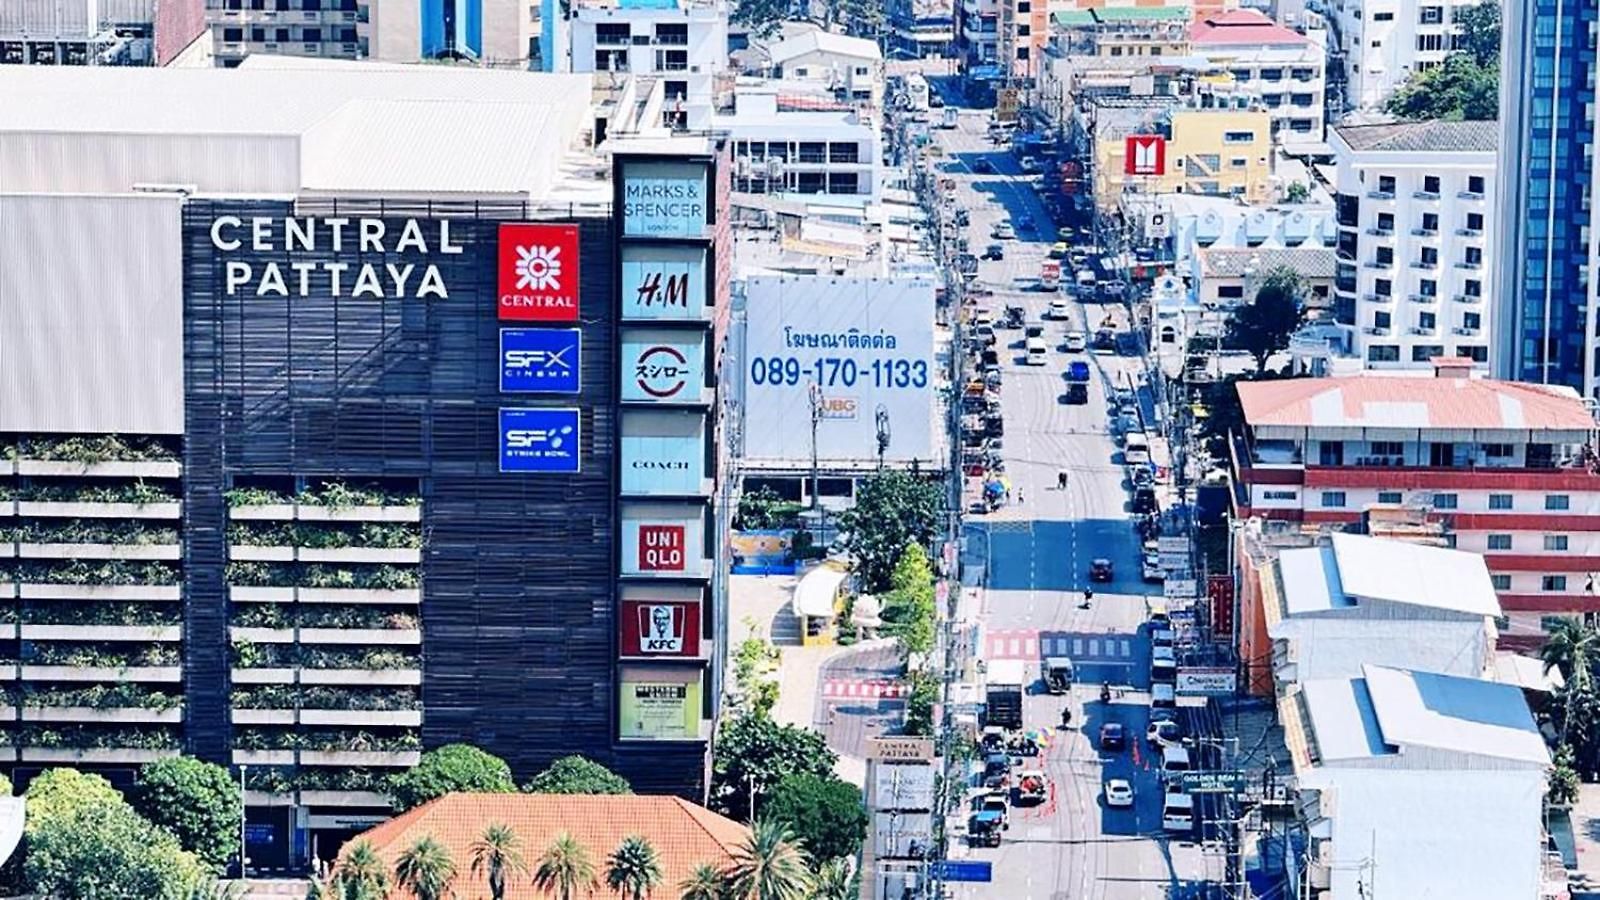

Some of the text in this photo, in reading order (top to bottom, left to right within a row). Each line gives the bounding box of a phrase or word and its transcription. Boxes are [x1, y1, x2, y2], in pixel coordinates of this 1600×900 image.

[627, 185, 698, 199] MARKS &
[624, 203, 701, 217] SPENCER
[210, 216, 464, 254] CENTRAL
[226, 261, 449, 298] PATTAYA
[637, 272, 689, 308] H&M
[501, 295, 575, 308] CENTRAL
[785, 326, 896, 349] โฆษณาติดต่อ
[505, 344, 576, 368] SFX
[636, 365, 689, 378] スシロー
[751, 356, 928, 389] 089-170-1133
[632, 461, 689, 470] COACH
[646, 531, 678, 547] UNI
[646, 549, 681, 566] QLO
[648, 639, 676, 650] KFC
